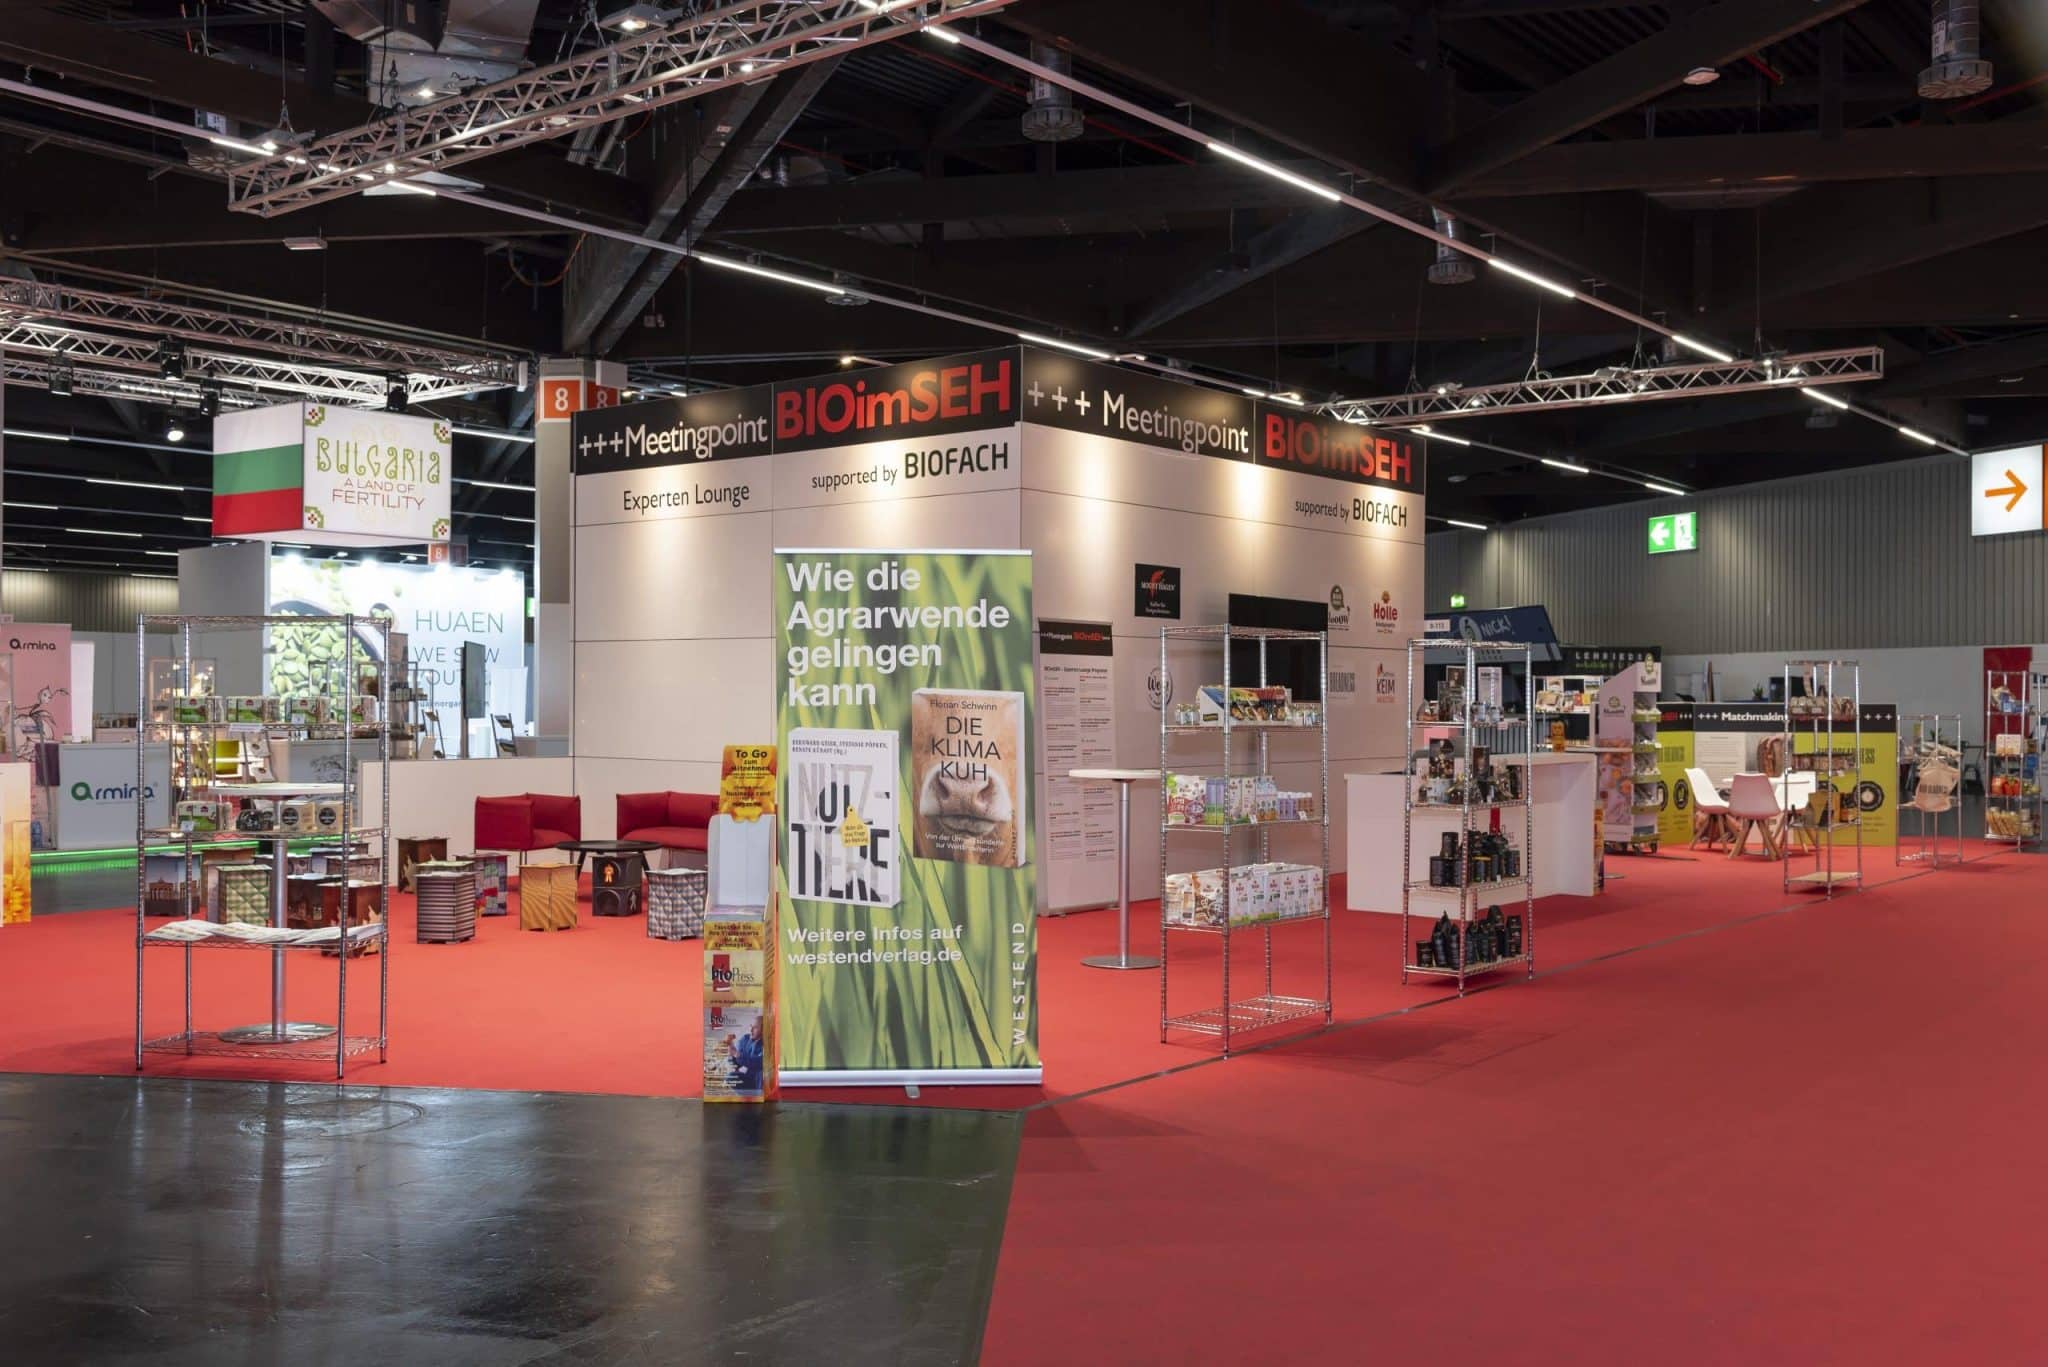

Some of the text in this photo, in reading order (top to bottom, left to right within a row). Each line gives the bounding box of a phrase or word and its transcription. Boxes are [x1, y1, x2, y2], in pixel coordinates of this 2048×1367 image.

[555, 387, 569, 411] 8
[776, 360, 1011, 440] BIOimSEH
[1103, 390, 1249, 454] Meetingpoint
[1265, 413, 1412, 485] BIOimSEH
[812, 442, 1009, 492] supported by BIOFACH
[344, 478, 415, 494] A LAND OF
[332, 488, 426, 511] FERTILITY
[623, 483, 750, 515] Experten Lounge
[1295, 498, 1408, 528] supported by BIOFACH
[786, 561, 921, 592] Wie die
[415, 609, 503, 633] HUAEN
[786, 598, 1010, 637] Agrarwende
[1373, 603, 1398, 621] Holle
[414, 646, 499, 663] WE SW
[787, 639, 942, 676] gelingen
[788, 678, 876, 707] kann
[961, 700, 997, 711] Schwinn
[1722, 711, 1785, 721] Matchmakin
[946, 716, 983, 736] DIE
[736, 749, 767, 758] To Go
[931, 738, 1001, 760] KLIMA
[940, 761, 987, 782] KUH
[787, 925, 963, 943] Weitere Infos auf
[787, 948, 962, 966] westendverlag.de
[1012, 922, 1026, 1046] WESTEND
